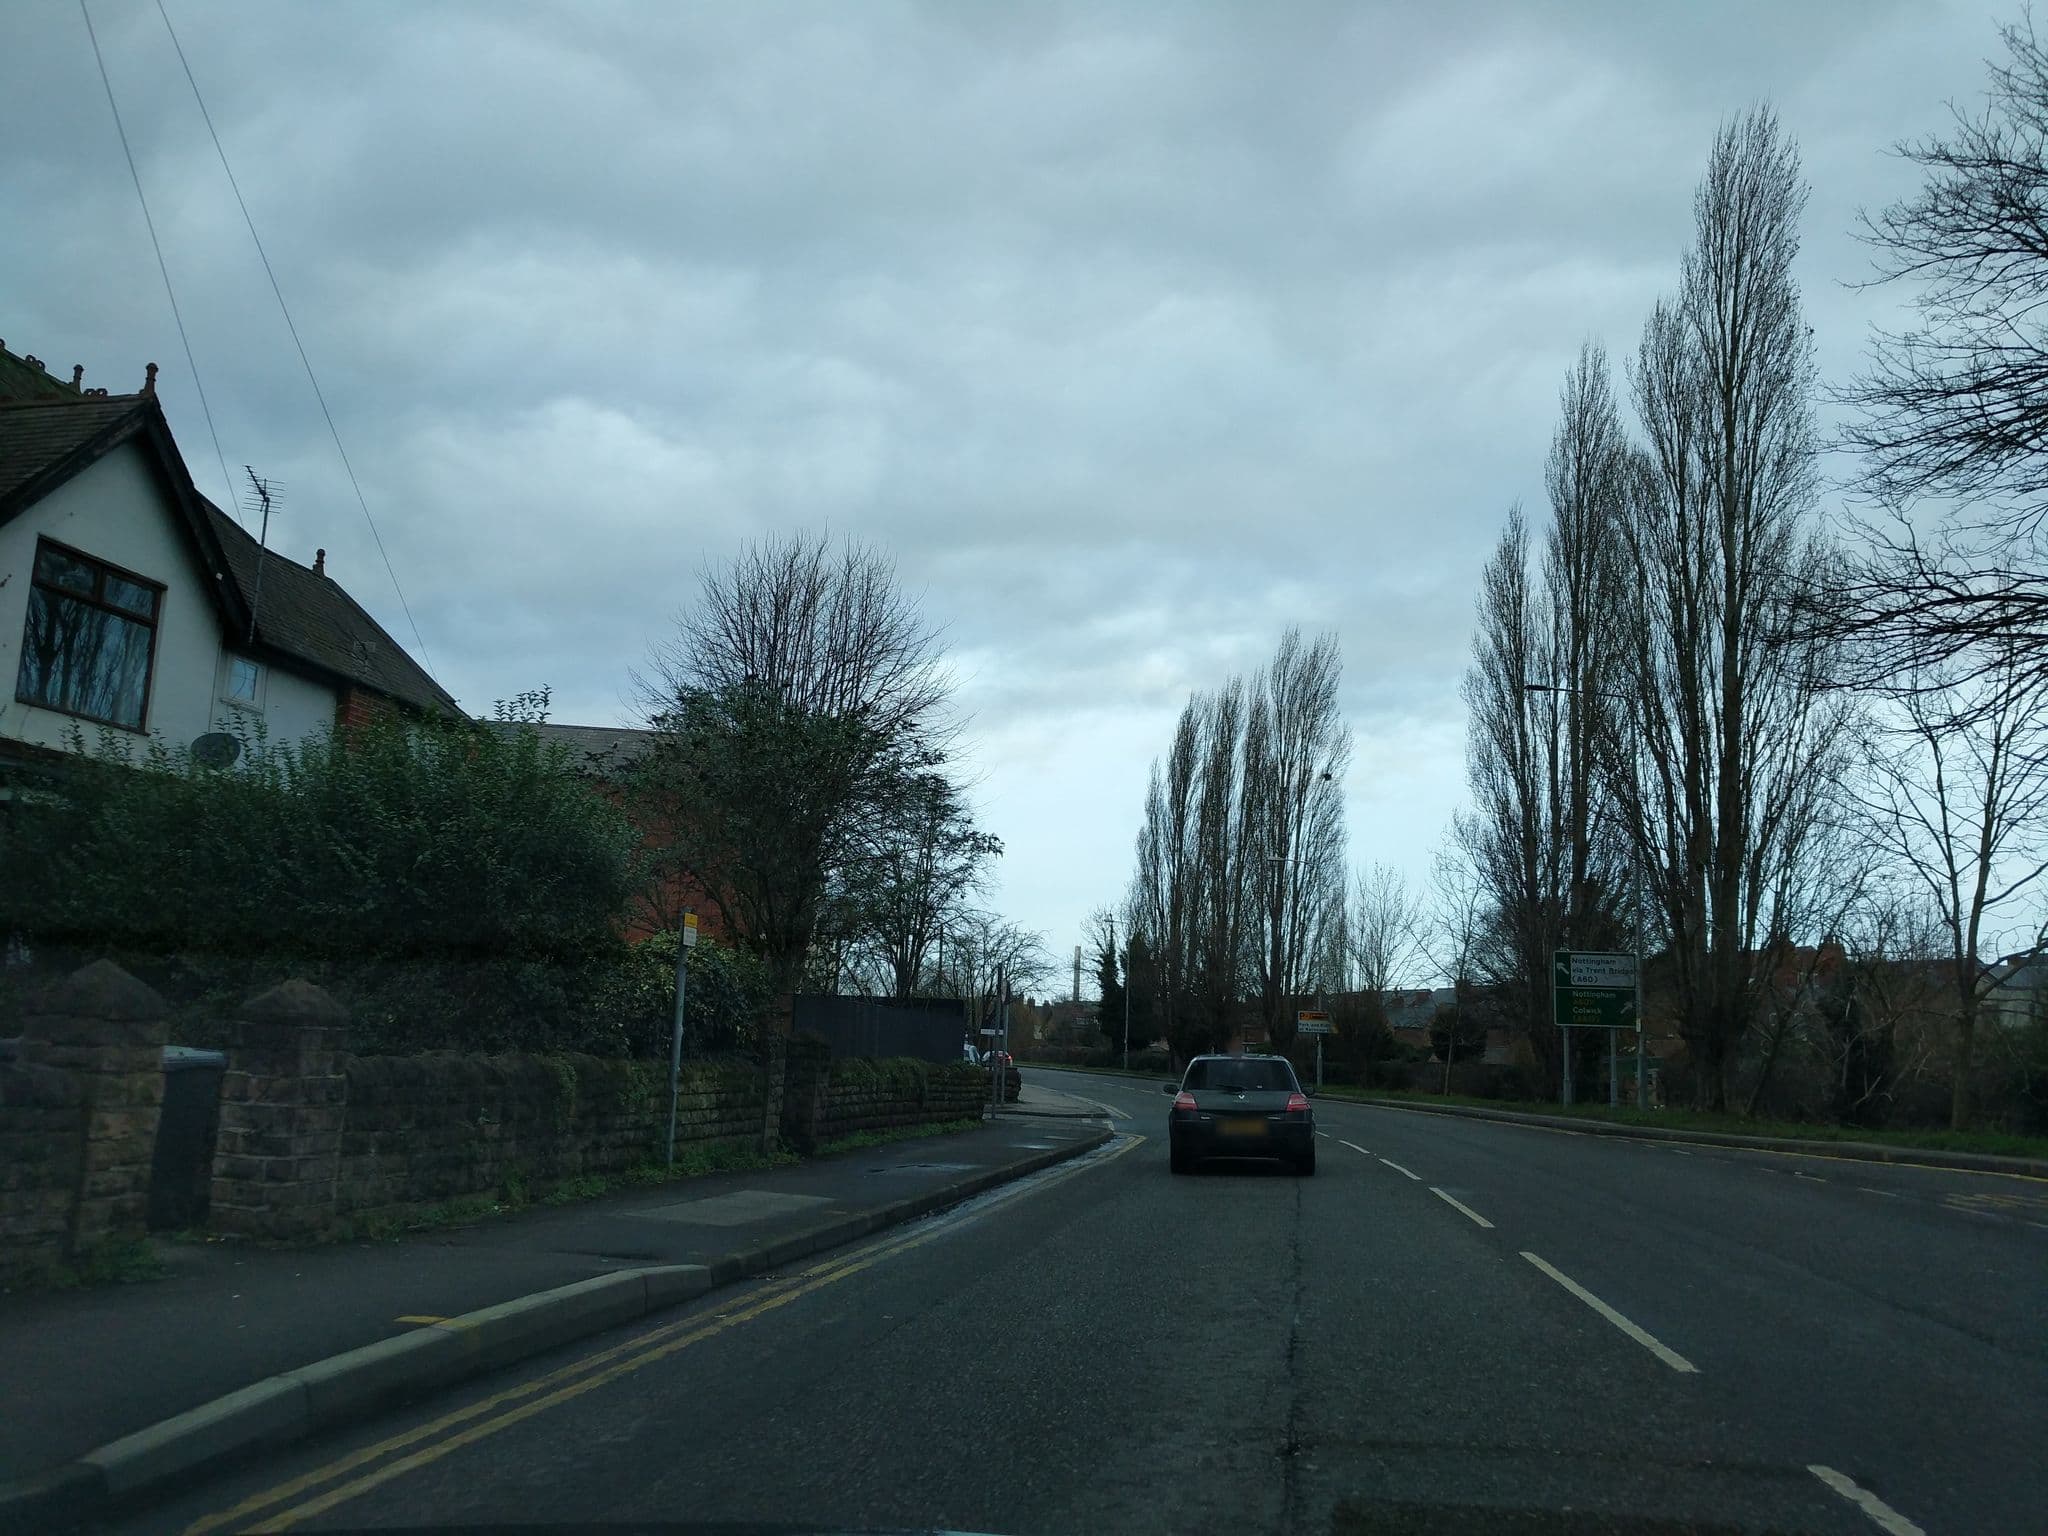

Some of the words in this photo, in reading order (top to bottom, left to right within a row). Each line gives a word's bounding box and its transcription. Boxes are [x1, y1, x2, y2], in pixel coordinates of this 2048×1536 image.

[1571, 958, 1617, 966] Nottingham
[1572, 975, 1598, 984] (A60)
[1573, 991, 1617, 999] Nottingham
